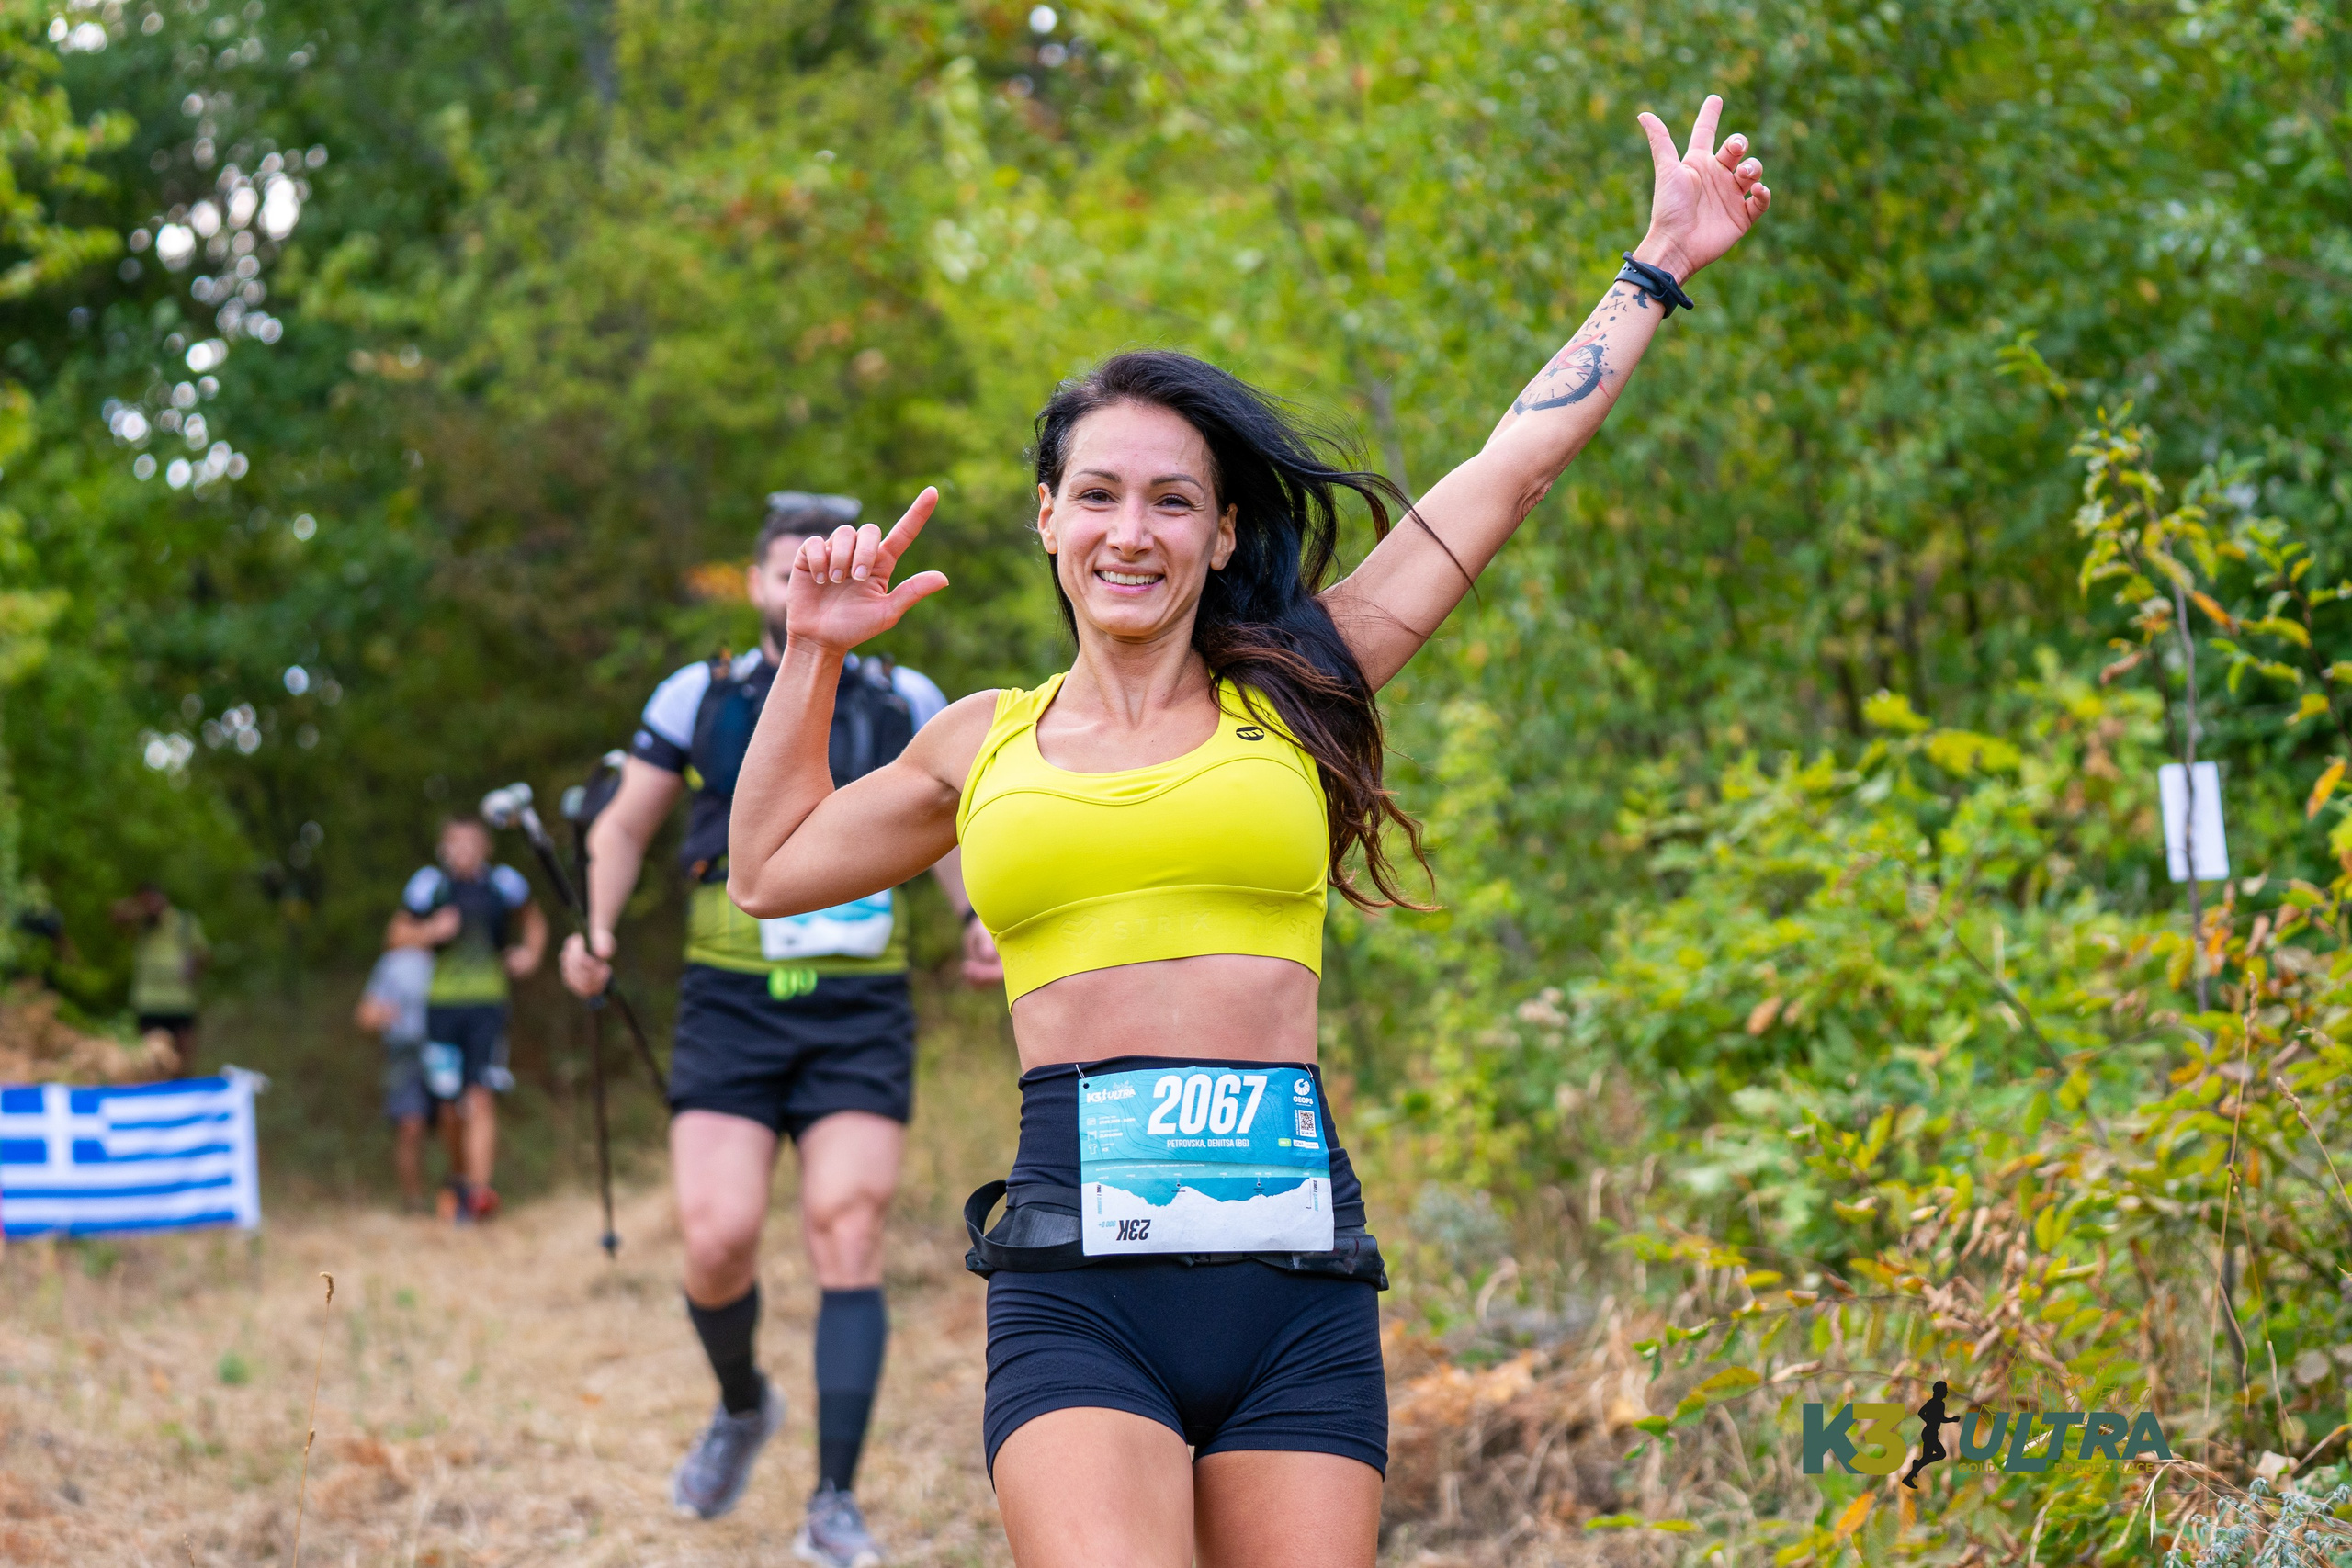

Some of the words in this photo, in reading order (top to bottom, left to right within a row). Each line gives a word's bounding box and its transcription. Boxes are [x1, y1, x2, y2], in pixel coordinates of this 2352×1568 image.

[1107, 1088, 1136, 1100] ULTRA
[1147, 1073, 1268, 1135] 2067
[1167, 1139, 1206, 1148] PETROVSKA,
[1207, 1138, 1235, 1147] DENITSA
[1235, 1138, 1250, 1147] (BG)
[1115, 1218, 1152, 1242] 23K
